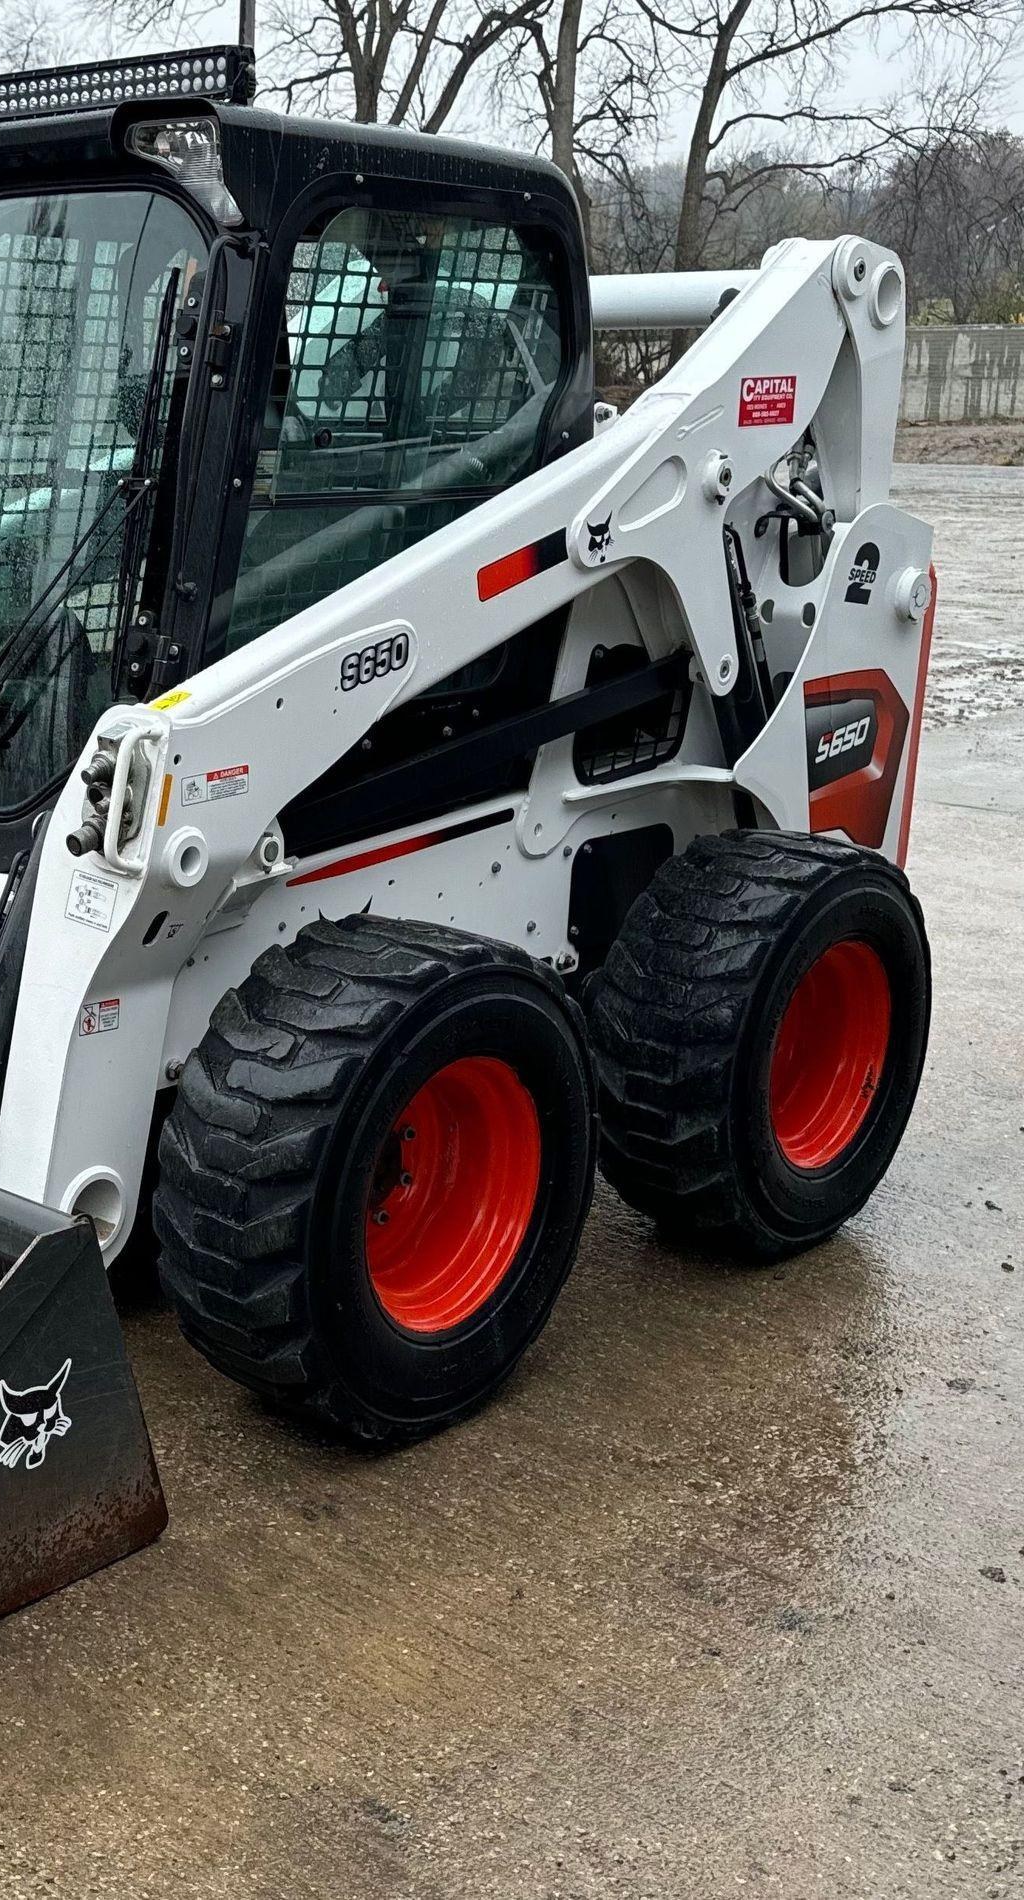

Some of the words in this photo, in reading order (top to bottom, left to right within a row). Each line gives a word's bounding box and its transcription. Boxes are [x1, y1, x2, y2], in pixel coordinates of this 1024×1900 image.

[742, 378, 794, 402] CAPITAL
[844, 542, 880, 605] 2
[848, 567, 877, 584] SPEED
[340, 632, 409, 692] S650
[815, 715, 870, 764] S650
[220, 767, 244, 778] DANGER
